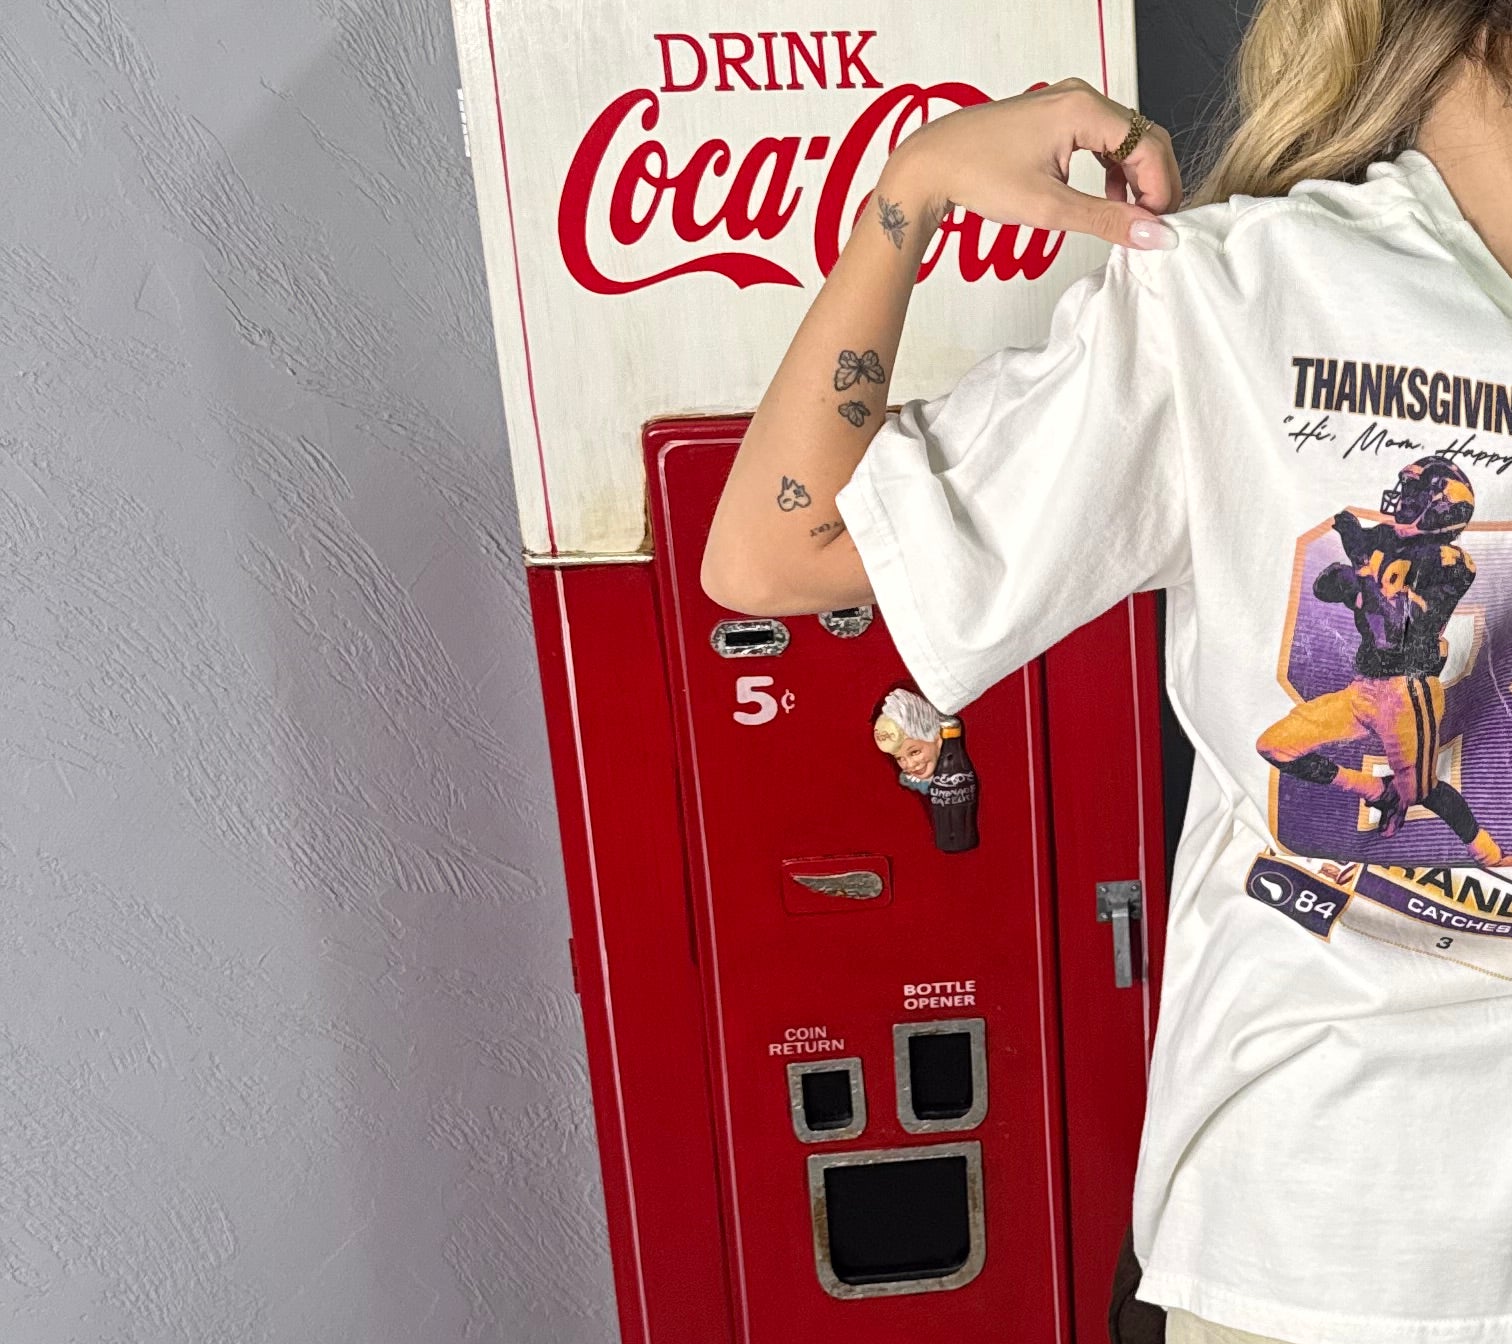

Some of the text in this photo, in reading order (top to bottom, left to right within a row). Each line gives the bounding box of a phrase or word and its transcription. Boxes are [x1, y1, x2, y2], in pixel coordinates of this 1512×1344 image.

[653, 30, 884, 93] DRINK
[1294, 889, 1337, 920] 84
[1407, 897, 1512, 934] CATCHES
[1435, 936, 1454, 949] 3
[903, 980, 977, 996] BOTTLE
[903, 994, 976, 1010] OPENER
[784, 1025, 828, 1042] COIN
[768, 1038, 845, 1056] RETURN
